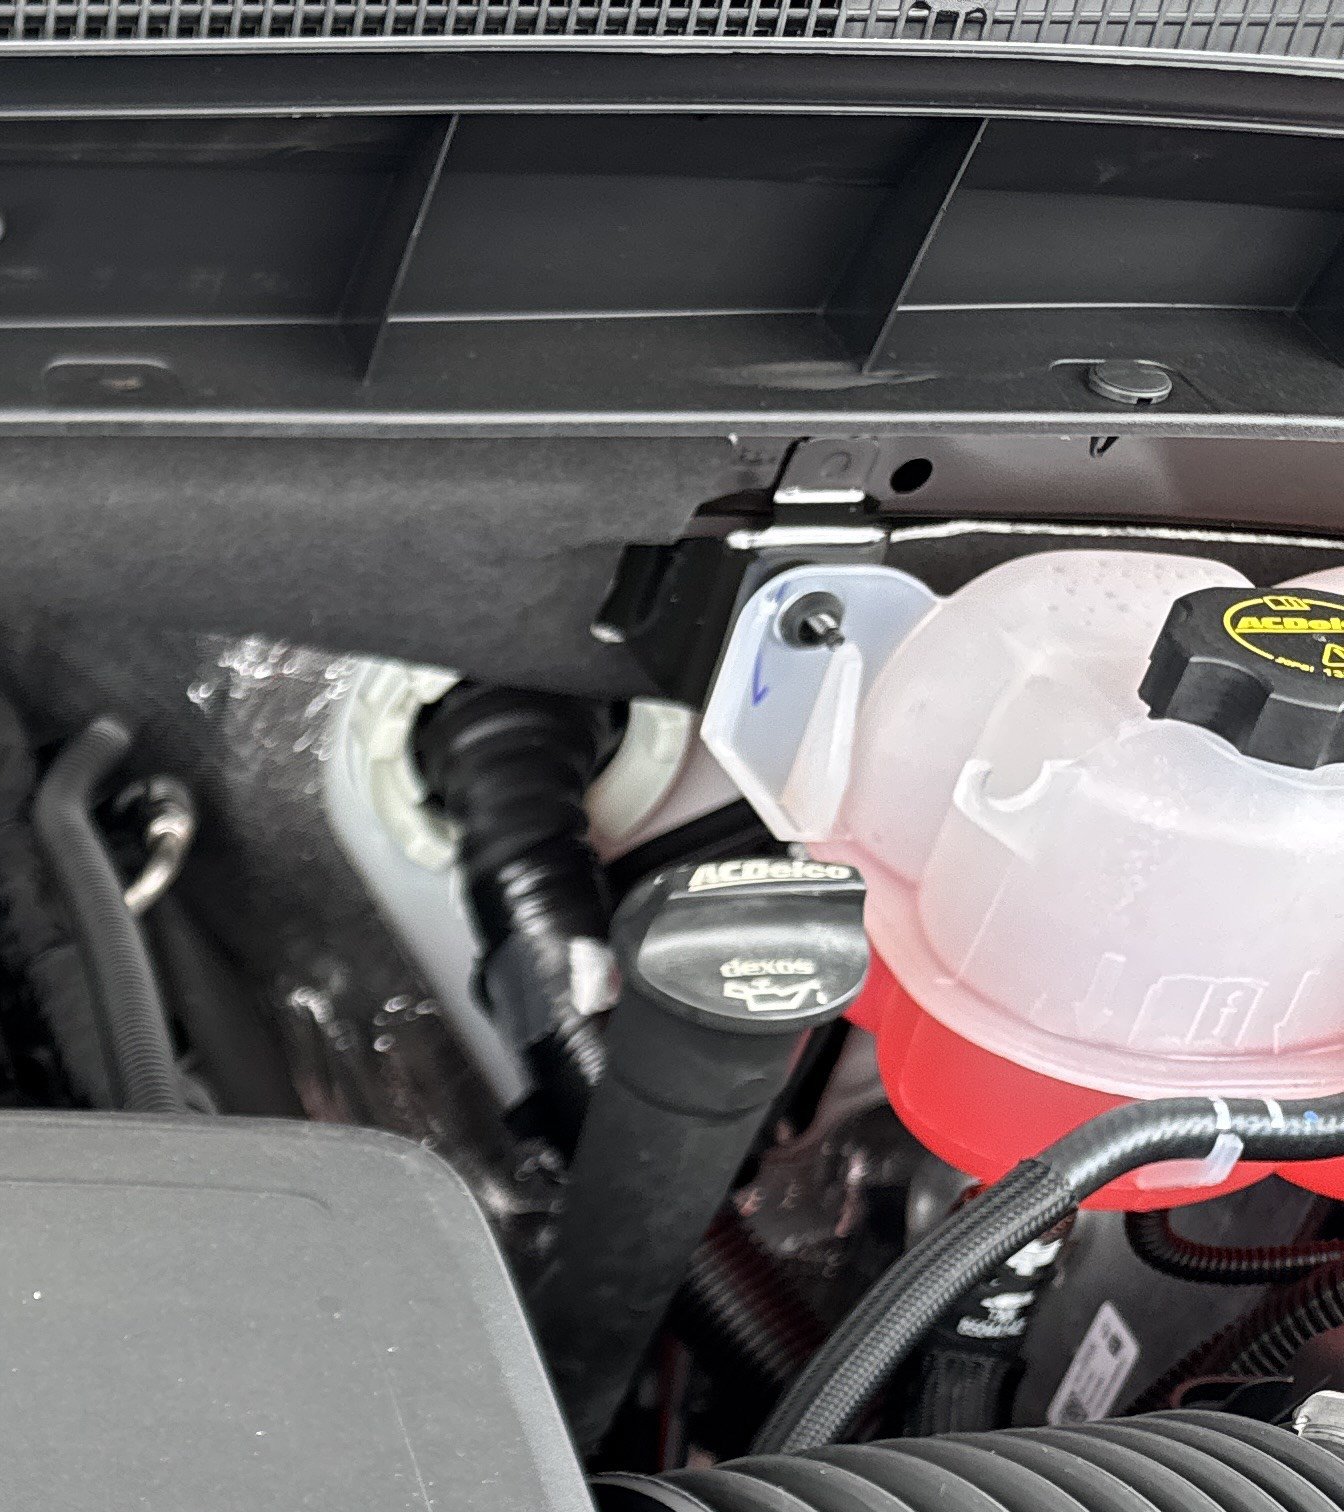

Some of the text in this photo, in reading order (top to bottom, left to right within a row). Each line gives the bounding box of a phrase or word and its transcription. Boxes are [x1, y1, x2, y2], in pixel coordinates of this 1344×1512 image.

[1236, 616, 1344, 630] ACDel
[689, 860, 850, 887] ACDelco
[720, 958, 815, 978] dexos
